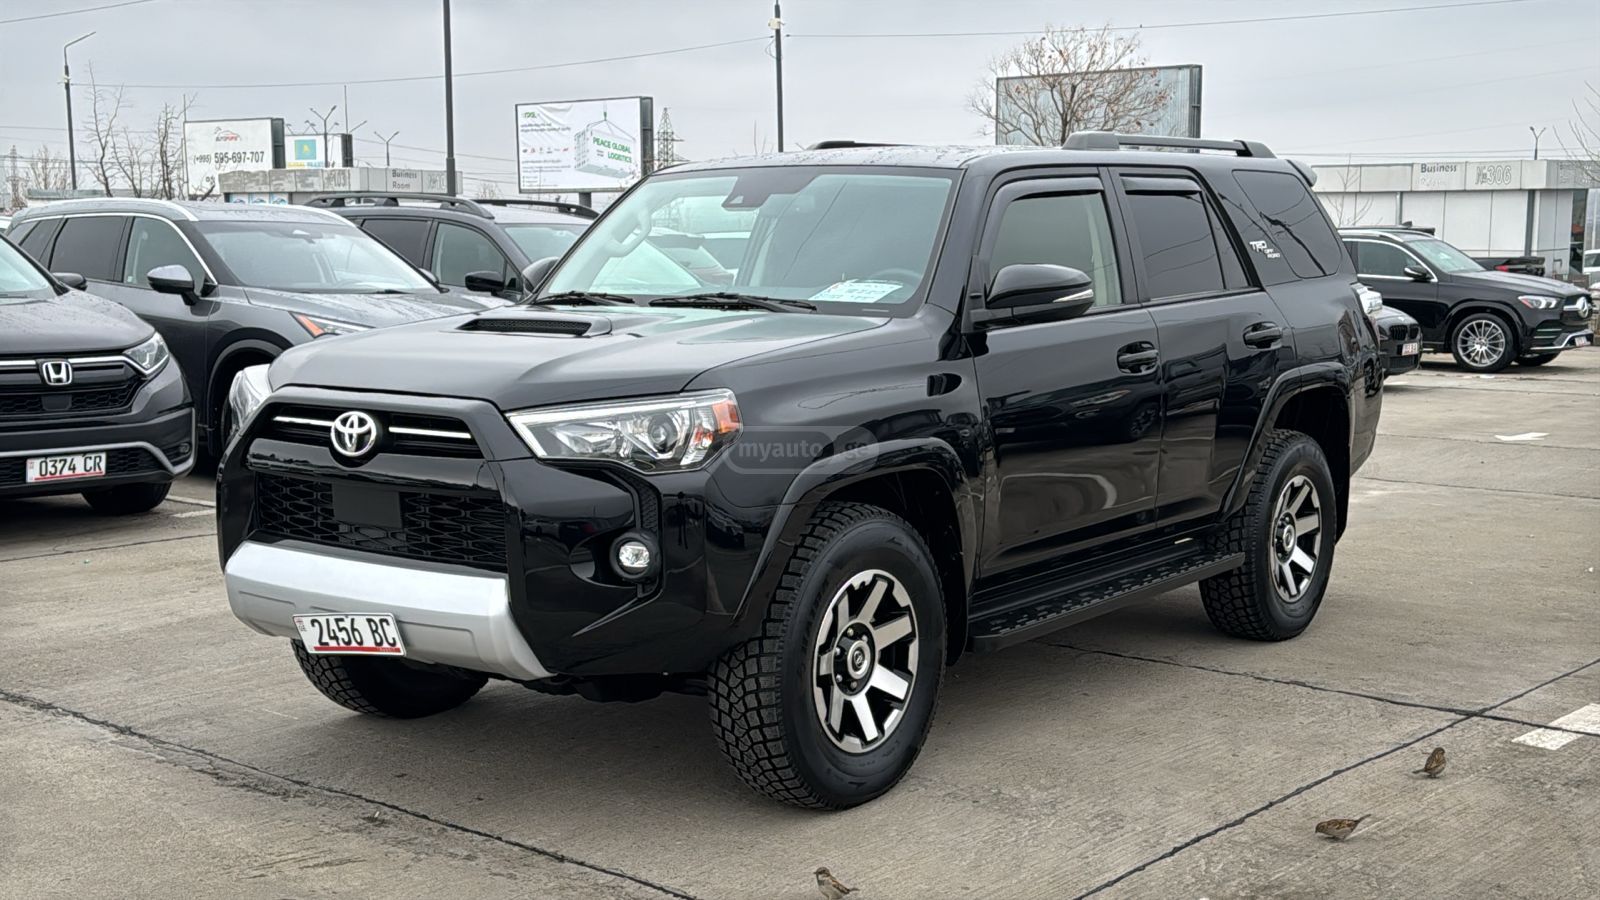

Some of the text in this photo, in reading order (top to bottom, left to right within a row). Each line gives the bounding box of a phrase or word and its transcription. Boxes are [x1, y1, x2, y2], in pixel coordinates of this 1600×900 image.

[593, 137, 631, 153] PEACE GLOBAL
[214, 151, 265, 163] 595-697-707
[608, 152, 632, 163] LOGISTICS
[392, 169, 417, 178] Business
[1421, 163, 1457, 173] Business
[392, 181, 411, 189] Room
[39, 455, 102, 477] 0374 CR
[310, 618, 397, 648] 2456 BC
